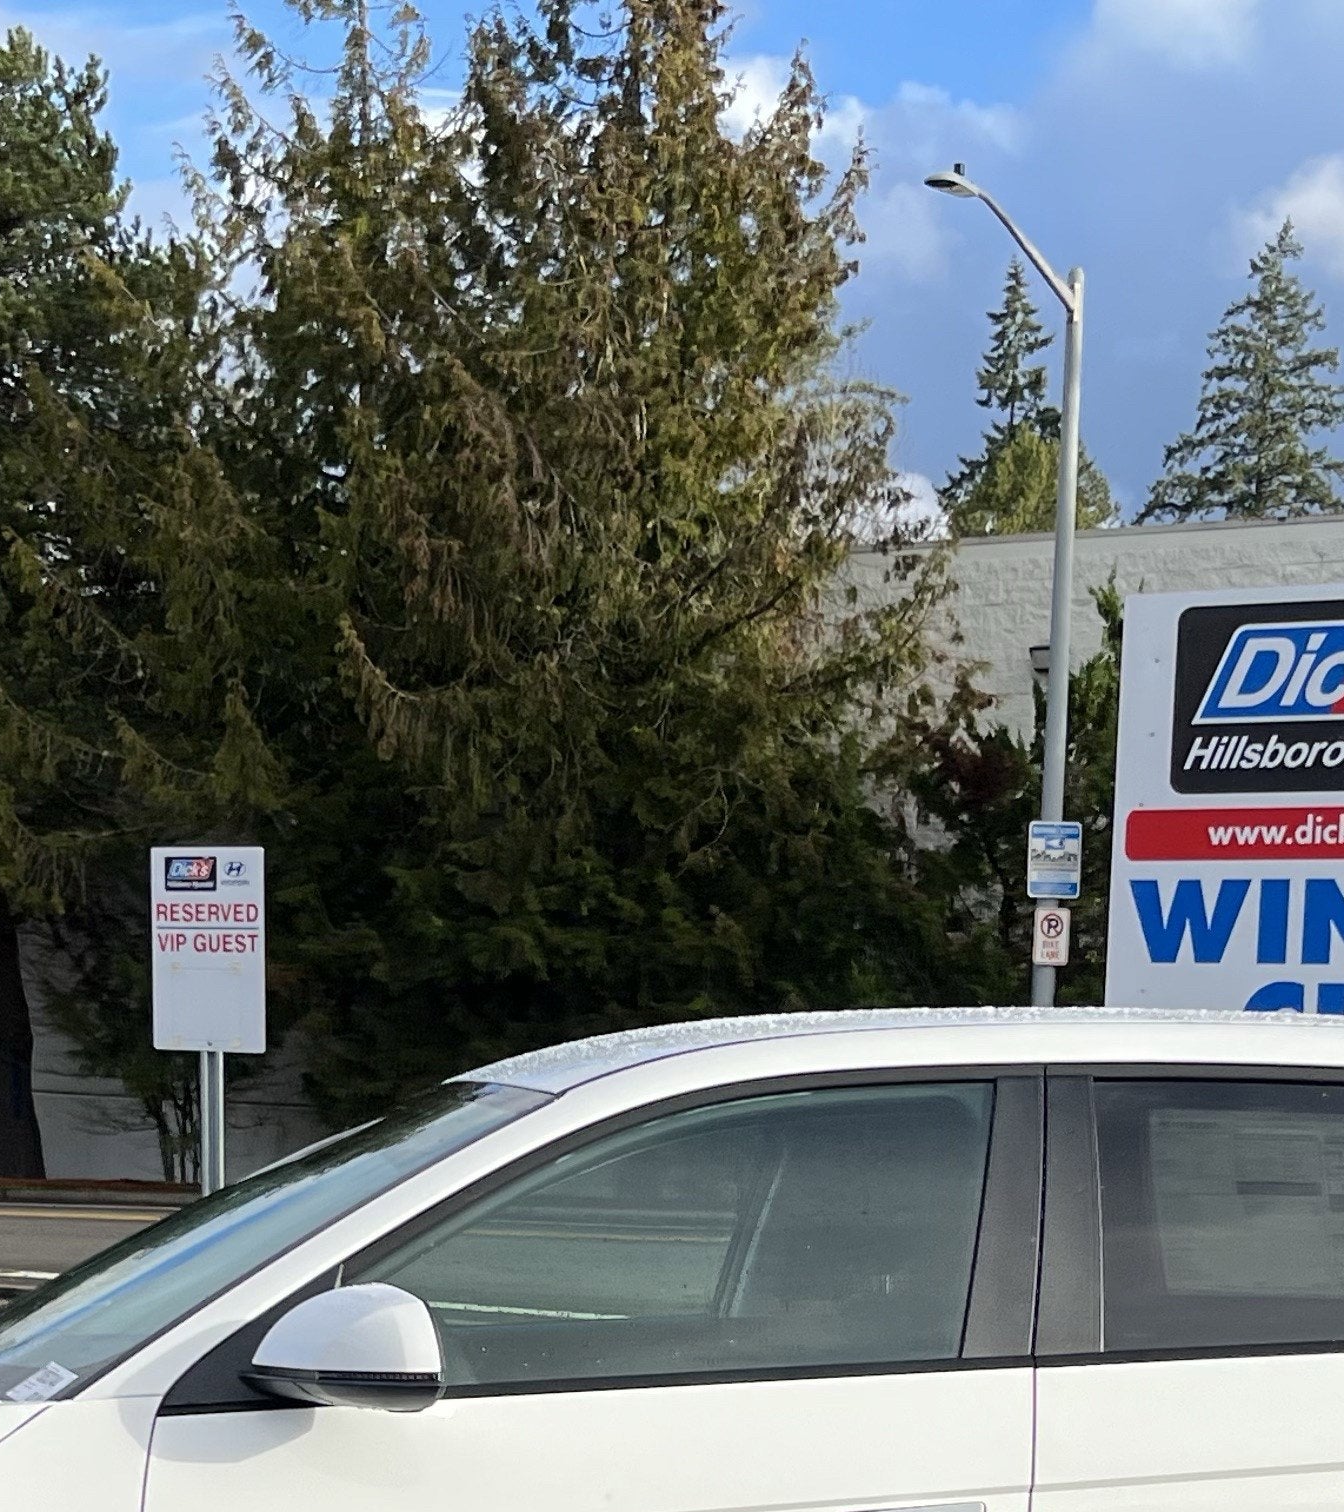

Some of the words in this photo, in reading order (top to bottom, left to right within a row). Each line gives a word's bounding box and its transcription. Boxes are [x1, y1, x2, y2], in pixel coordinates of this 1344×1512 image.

[156, 903, 259, 923] RESERVED
[158, 933, 187, 952] VIP
[193, 934, 259, 954] GUEST
